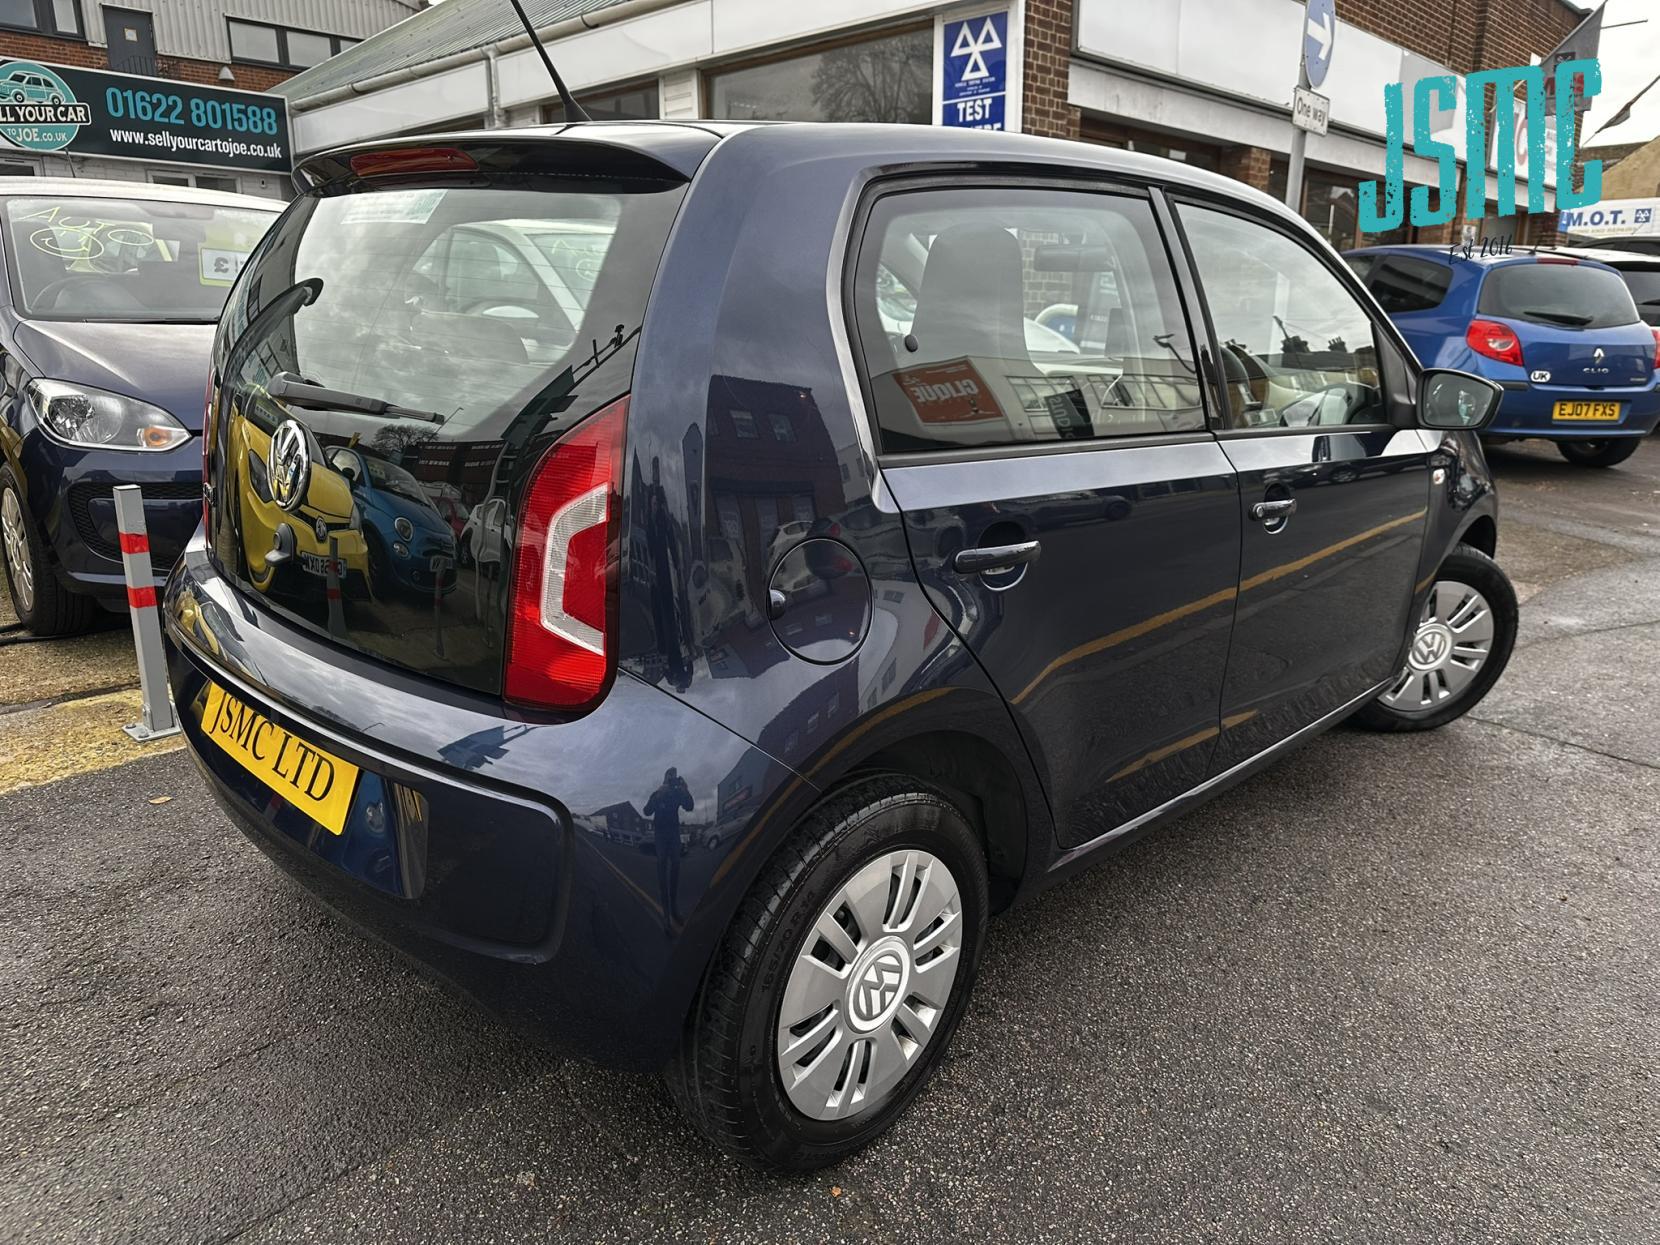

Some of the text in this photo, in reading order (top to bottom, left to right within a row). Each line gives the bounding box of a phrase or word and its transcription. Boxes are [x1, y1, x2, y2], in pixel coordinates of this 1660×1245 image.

[15, 106, 57, 122] YOUR
[57, 106, 87, 122] CAR
[106, 87, 278, 135] 01622 801588
[957, 98, 992, 123] TEST
[1297, 97, 1327, 127] One way
[7, 127, 68, 142] TO JOE.CO.UK
[110, 129, 282, 159] www.sellyourcartojoe.co.uk
[1533, 372, 1549, 381] UK
[1558, 403, 1616, 417] EJ07 FXS
[209, 691, 335, 801] JSMC LTD
